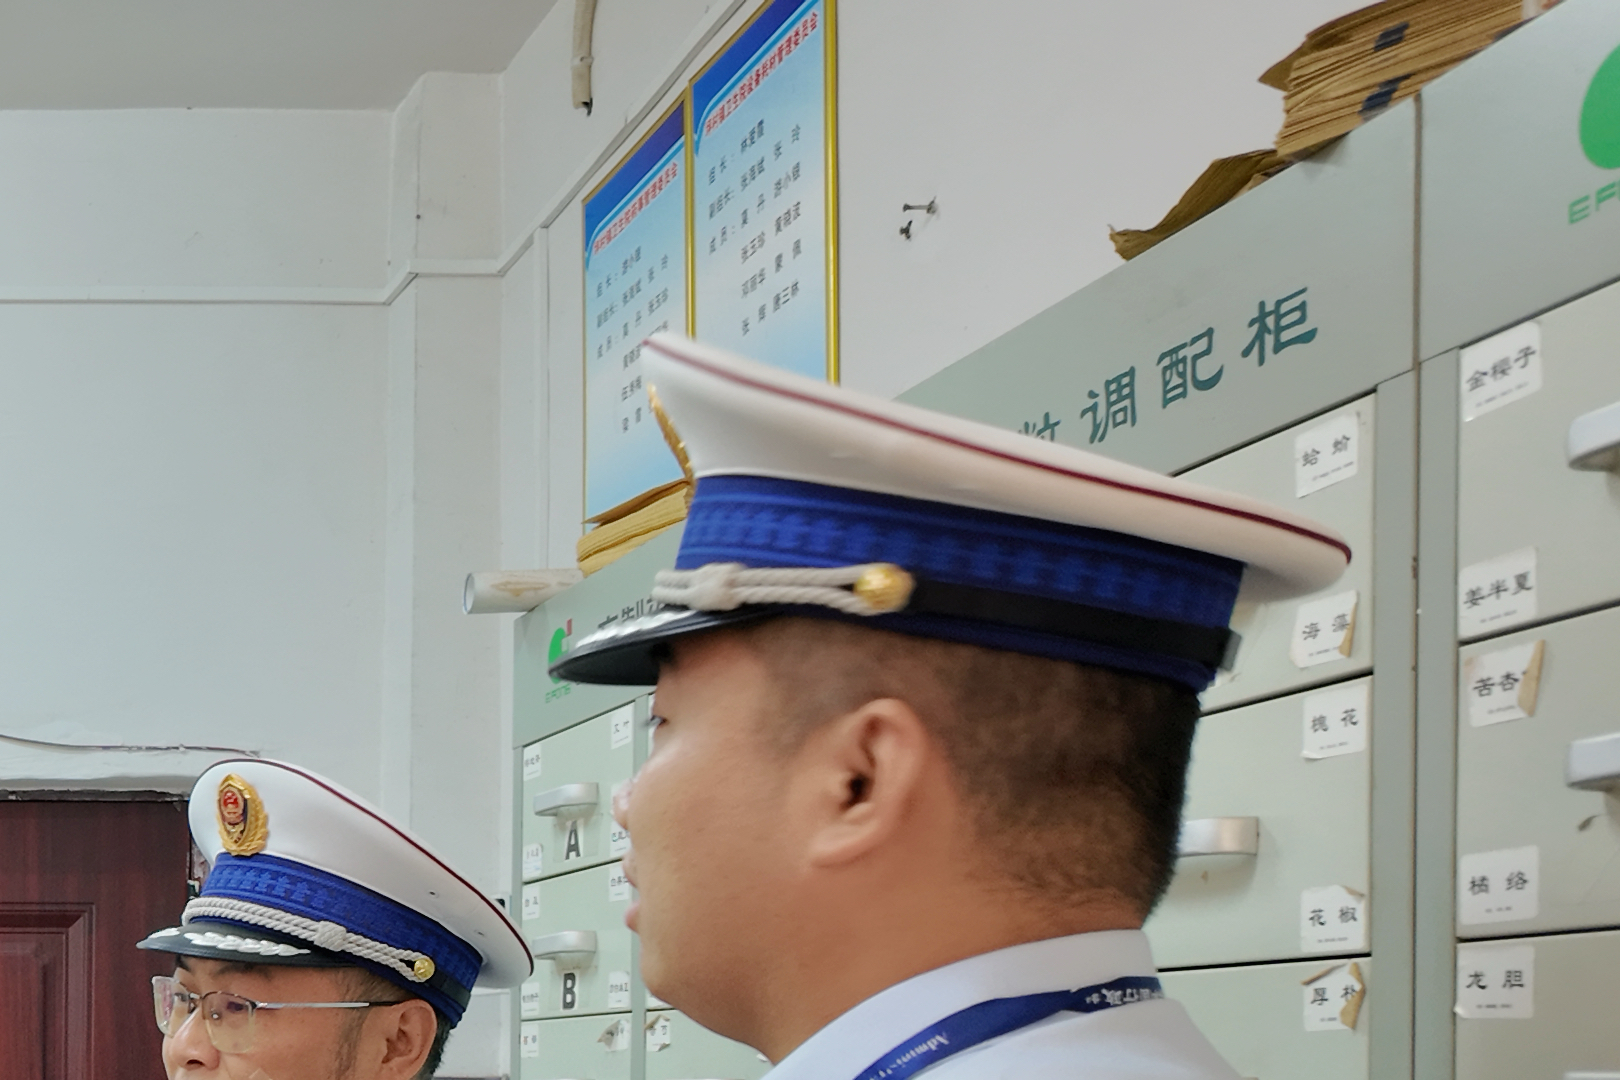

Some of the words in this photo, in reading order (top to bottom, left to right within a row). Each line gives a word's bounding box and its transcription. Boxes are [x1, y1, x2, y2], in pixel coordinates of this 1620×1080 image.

[1568, 178, 1620, 225] EF
[1465, 345, 1538, 393] 金樱子
[1301, 434, 1351, 467] 蛤蚧
[1464, 573, 1534, 609] 姜半夏
[1302, 613, 1350, 641] 海藻
[1472, 669, 1528, 699] 苦杏
[1310, 708, 1359, 733] 槐花
[565, 820, 580, 860] A
[1468, 869, 1528, 895] 橘络
[1309, 906, 1358, 926] 花椒
[563, 973, 576, 1010] B
[1466, 970, 1525, 990] 龙胆
